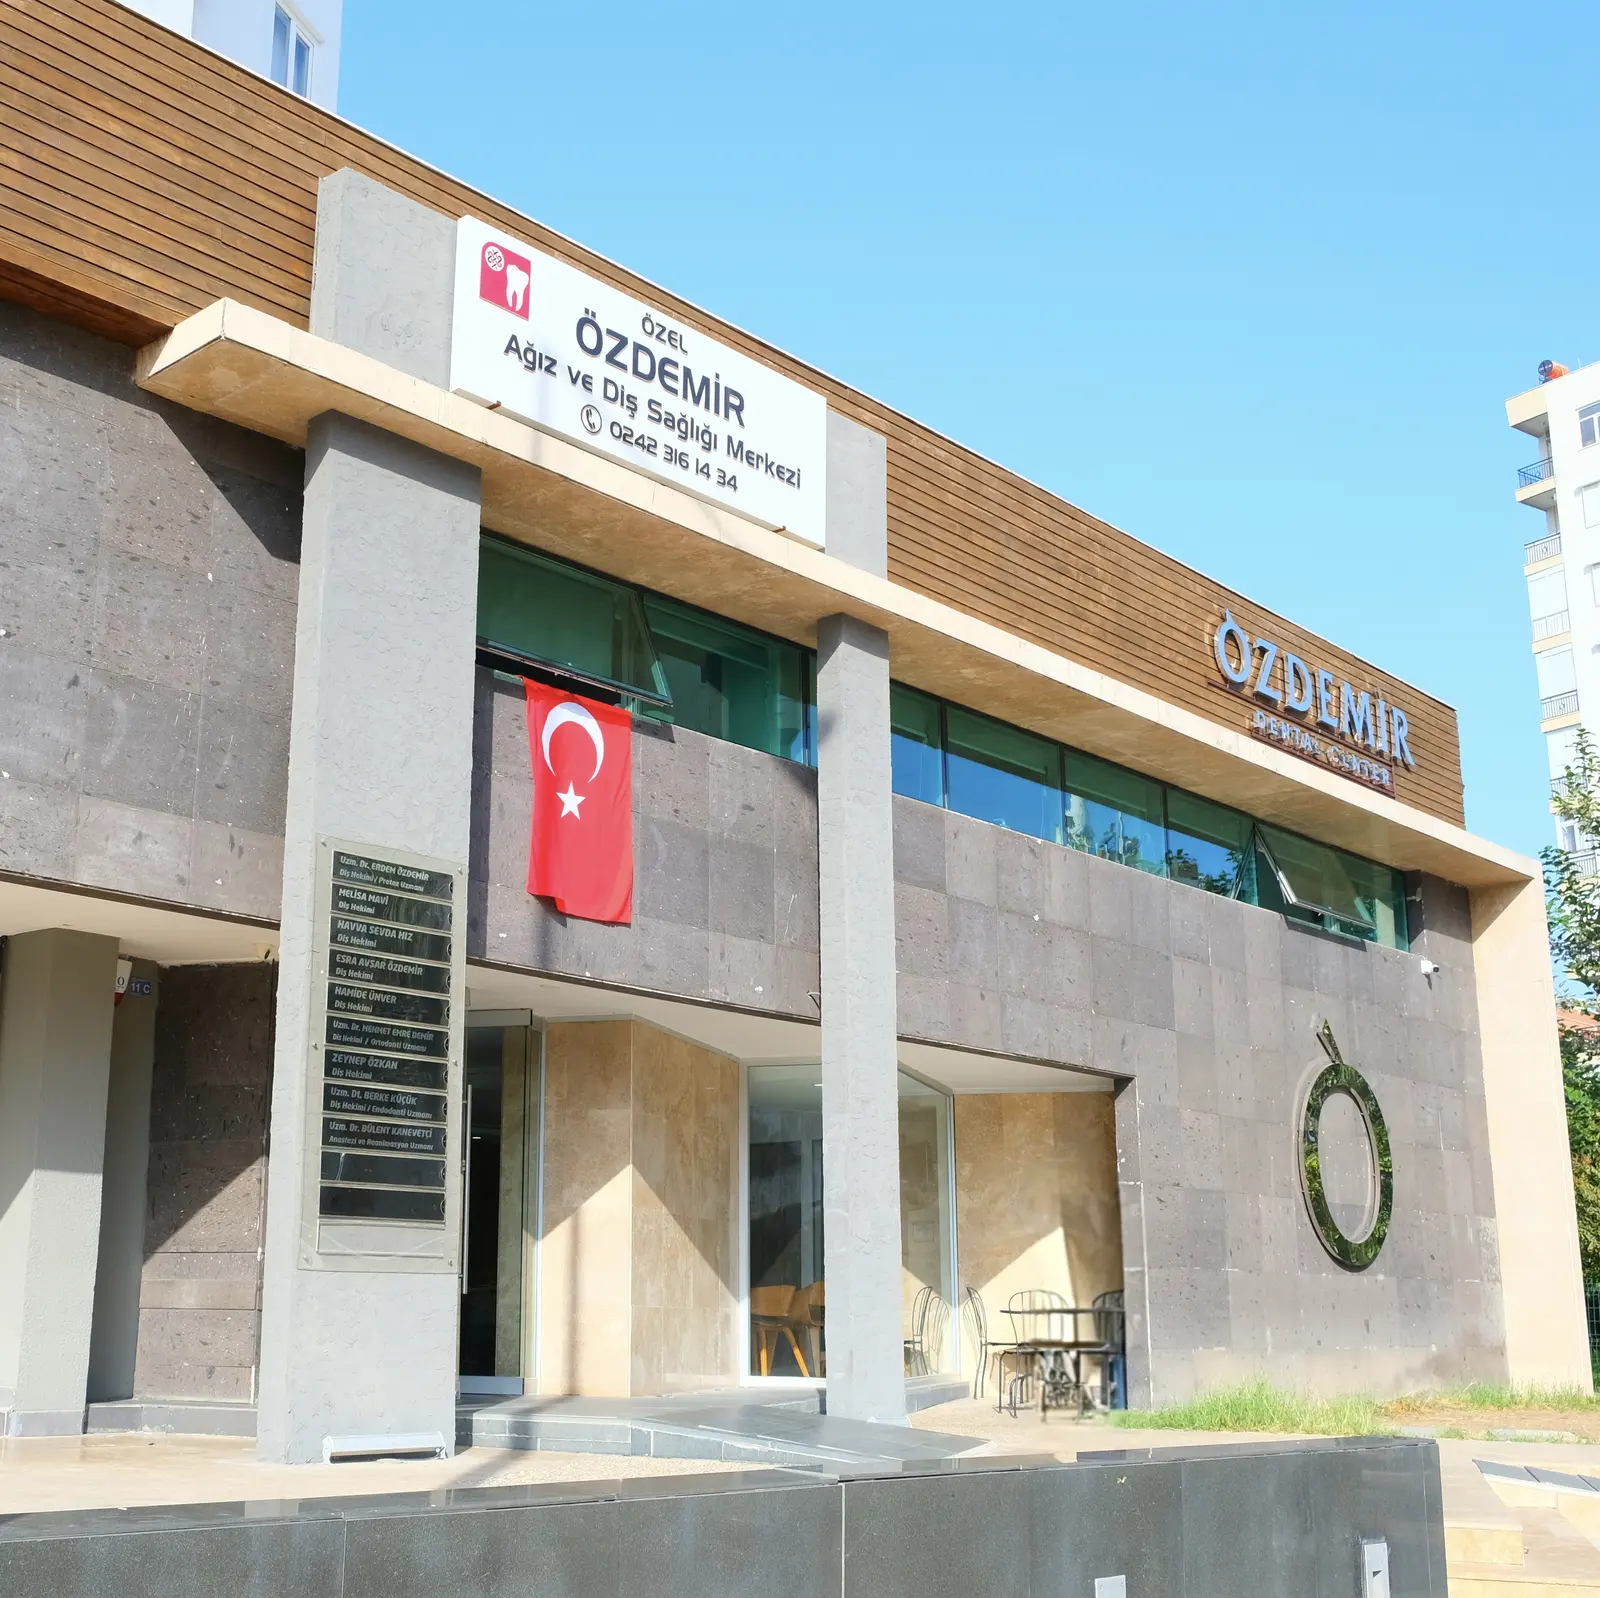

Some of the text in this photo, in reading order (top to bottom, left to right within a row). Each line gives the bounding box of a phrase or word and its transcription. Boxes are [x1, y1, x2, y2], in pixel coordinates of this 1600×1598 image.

[641, 312, 688, 355] ÖZEL
[575, 307, 745, 427] ÖZDEMİR
[503, 334, 802, 489] Ağız ve Diş Sağlığı Merkezi
[610, 420, 738, 492] 0242 316 14 34
[1254, 710, 1390, 785] DENTAL CENTER
[340, 856, 429, 880] Uzm. Dr. ERDEM ÖZDEMİR
[351, 870, 373, 881] Hekimi
[379, 876, 399, 887] Protez
[401, 881, 424, 891] Uzmanı
[339, 888, 388, 905] MELİSA MAVİ
[339, 901, 375, 914] Diş Hekimi
[337, 920, 413, 941] HAVVA SEVDA HIZ
[337, 934, 376, 947] Diş Hekimi
[336, 954, 423, 976] ESRA AVŞAR ÖZDEMİR
[336, 967, 373, 980] Diş Hekimi
[131, 982, 140, 992] 11
[143, 984, 150, 994] C
[335, 986, 397, 1004] HAMİDE ÜNVER
[335, 1000, 372, 1012] Diş Hekimi
[333, 1020, 434, 1040] Uzm. Dr. MEHMET EMRE DEMİR
[371, 1039, 401, 1048] Ortodonti
[332, 1053, 398, 1070] ZEYNEP ÖZKAN
[332, 1068, 372, 1080] Diş Hekimi
[331, 1087, 350, 1097] Uzm.
[364, 1092, 389, 1102] BERKE
[390, 1094, 418, 1106] KÜÇÜK
[330, 1101, 341, 1109] Diş
[342, 1102, 365, 1112] Hekimi
[372, 1106, 405, 1116] Endodonti
[407, 1110, 432, 1119] Uzmanı
[329, 1122, 432, 1139] Uzm. Dr. BÜLENT KANEVETÇİ
[367, 1138, 408, 1149] Reanimasyon
